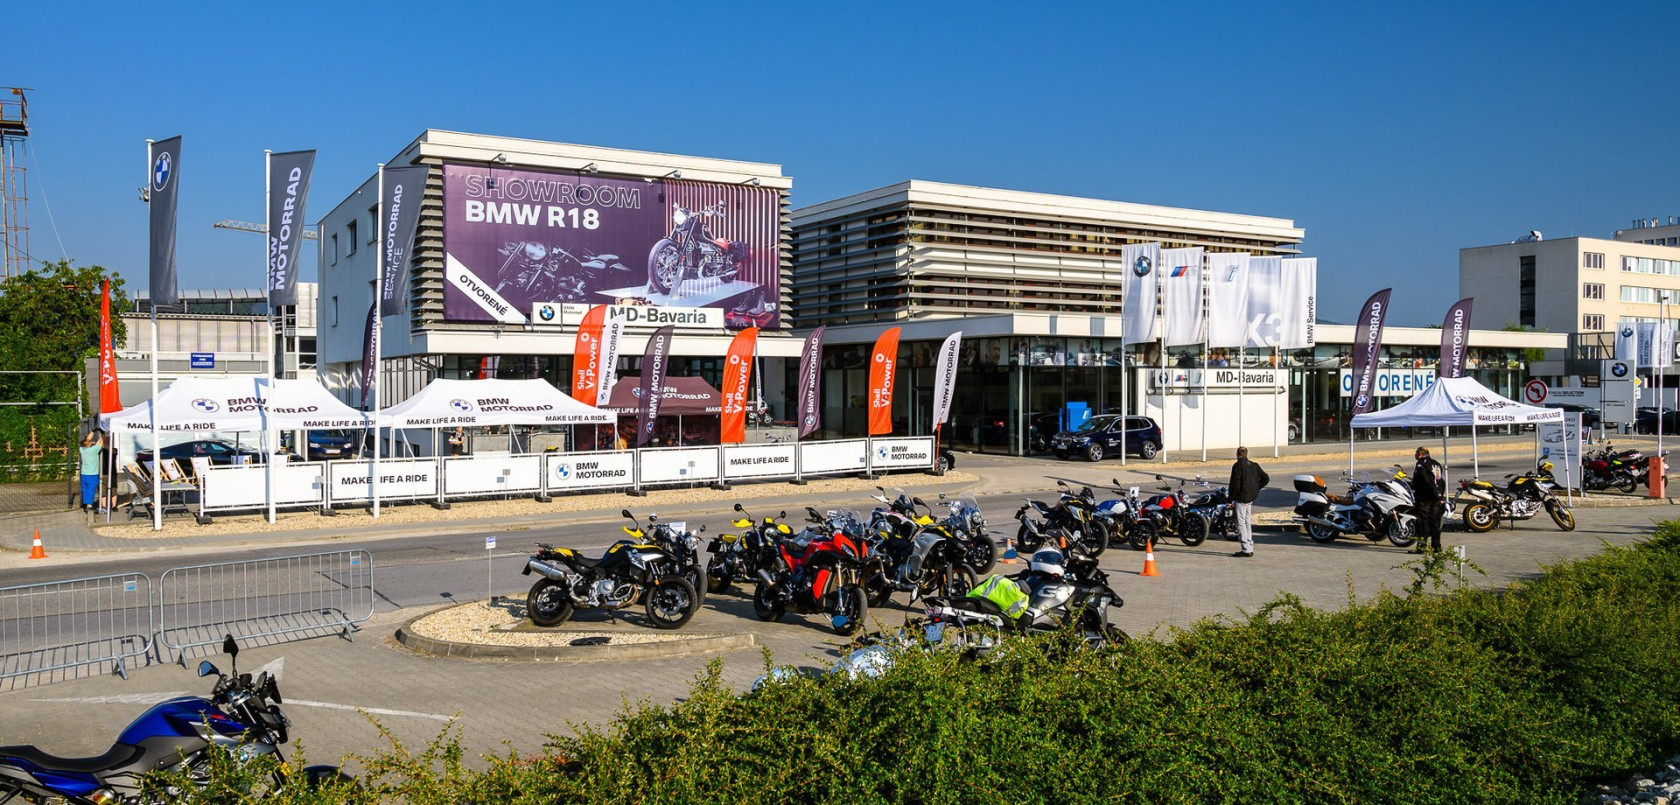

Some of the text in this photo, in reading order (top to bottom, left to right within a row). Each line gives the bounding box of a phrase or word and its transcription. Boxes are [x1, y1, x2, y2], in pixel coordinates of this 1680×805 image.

[465, 175, 641, 209] SHOWROOM
[387, 184, 403, 262] MOTORRAD
[465, 200, 600, 230] BMW R18
[275, 166, 302, 290] MOTORRAD
[459, 275, 508, 316] OTVORENÉ
[610, 306, 707, 324] MD-Bavaria
[1306, 295, 1314, 344] BMW Service
[1452, 308, 1464, 366] MOTORRAD
[585, 337, 598, 389] V-Power
[945, 340, 956, 389] MOTORRAD
[577, 369, 585, 390] Shell
[648, 335, 665, 419] BMW MOTORRAD
[733, 359, 748, 414] V-Power
[807, 338, 819, 413] BMW MOTORRAD
[881, 357, 893, 408] V-Power
[1216, 370, 1274, 384] MD-Bavaria
[1342, 370, 1434, 392] OORENÉ
[227, 397, 267, 406] BMW
[477, 397, 509, 406] BMW
[480, 404, 553, 413] MOTORRAD
[725, 392, 734, 414] Shell
[873, 388, 881, 408] Shell
[127, 422, 154, 430] MAK
[193, 422, 216, 430] RIDE
[432, 416, 449, 424] LIFE
[450, 416, 457, 424] A
[457, 415, 476, 423] RIDE
[576, 462, 599, 470] BMW
[730, 457, 752, 465] MAKE
[752, 457, 767, 465] LIFE
[767, 456, 773, 464] A
[891, 452, 927, 460] MOTORRAD
[341, 474, 428, 485] MAKE IFE A RIDE
[576, 469, 626, 479] MOTORRAD
